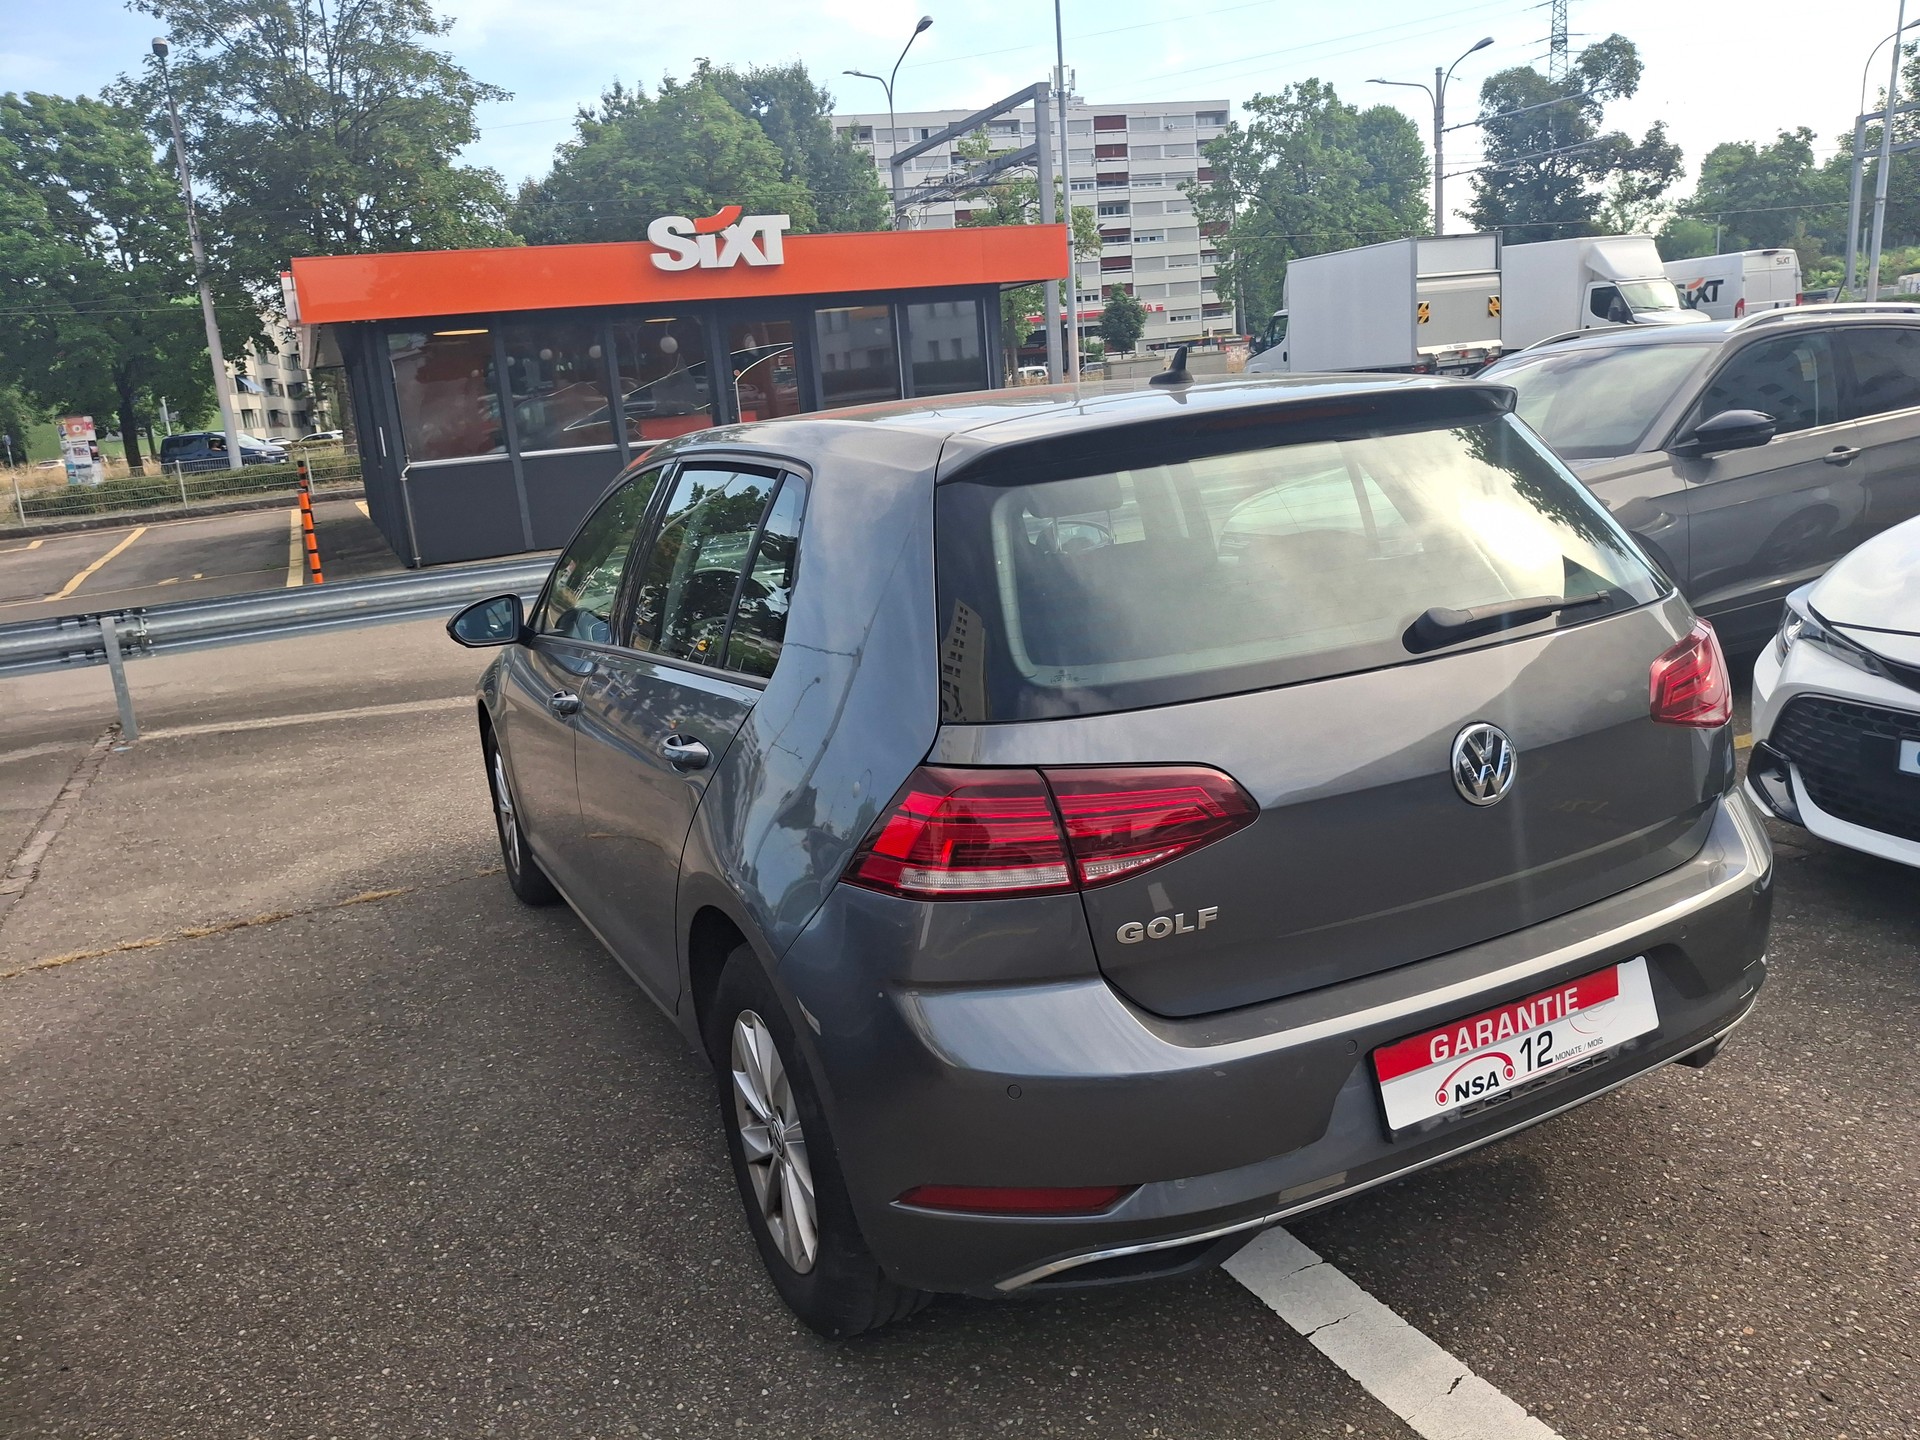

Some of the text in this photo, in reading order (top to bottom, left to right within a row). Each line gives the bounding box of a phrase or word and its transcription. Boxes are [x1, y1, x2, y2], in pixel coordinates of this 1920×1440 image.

[1454, 725, 1516, 804] VW
[1116, 906, 1219, 944] GOLF
[1430, 987, 1579, 1063] GARANTIE
[1520, 1030, 1553, 1072] 12
[1555, 1045, 1582, 1062] MONATE
[1588, 1037, 1604, 1048] MOIS
[1455, 1070, 1500, 1102] NSA
